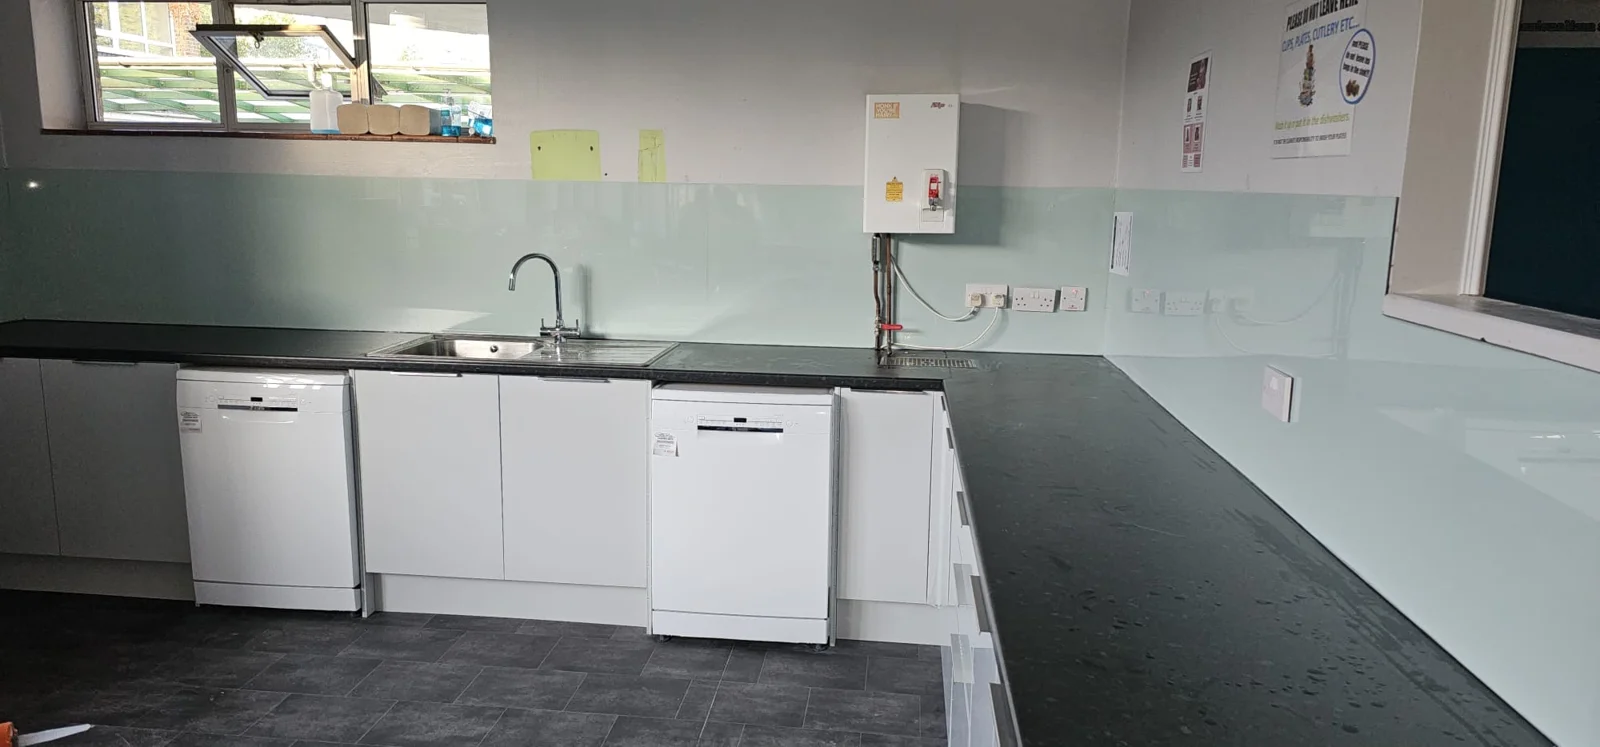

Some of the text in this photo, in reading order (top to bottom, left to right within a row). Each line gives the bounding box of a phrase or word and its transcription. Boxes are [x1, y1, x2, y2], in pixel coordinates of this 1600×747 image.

[1287, 11, 1303, 32] PLEASE
[1309, 2, 1320, 22] NOT
[1320, 0, 1338, 17] LEAVE
[1313, 21, 1340, 41] CUTLERY
